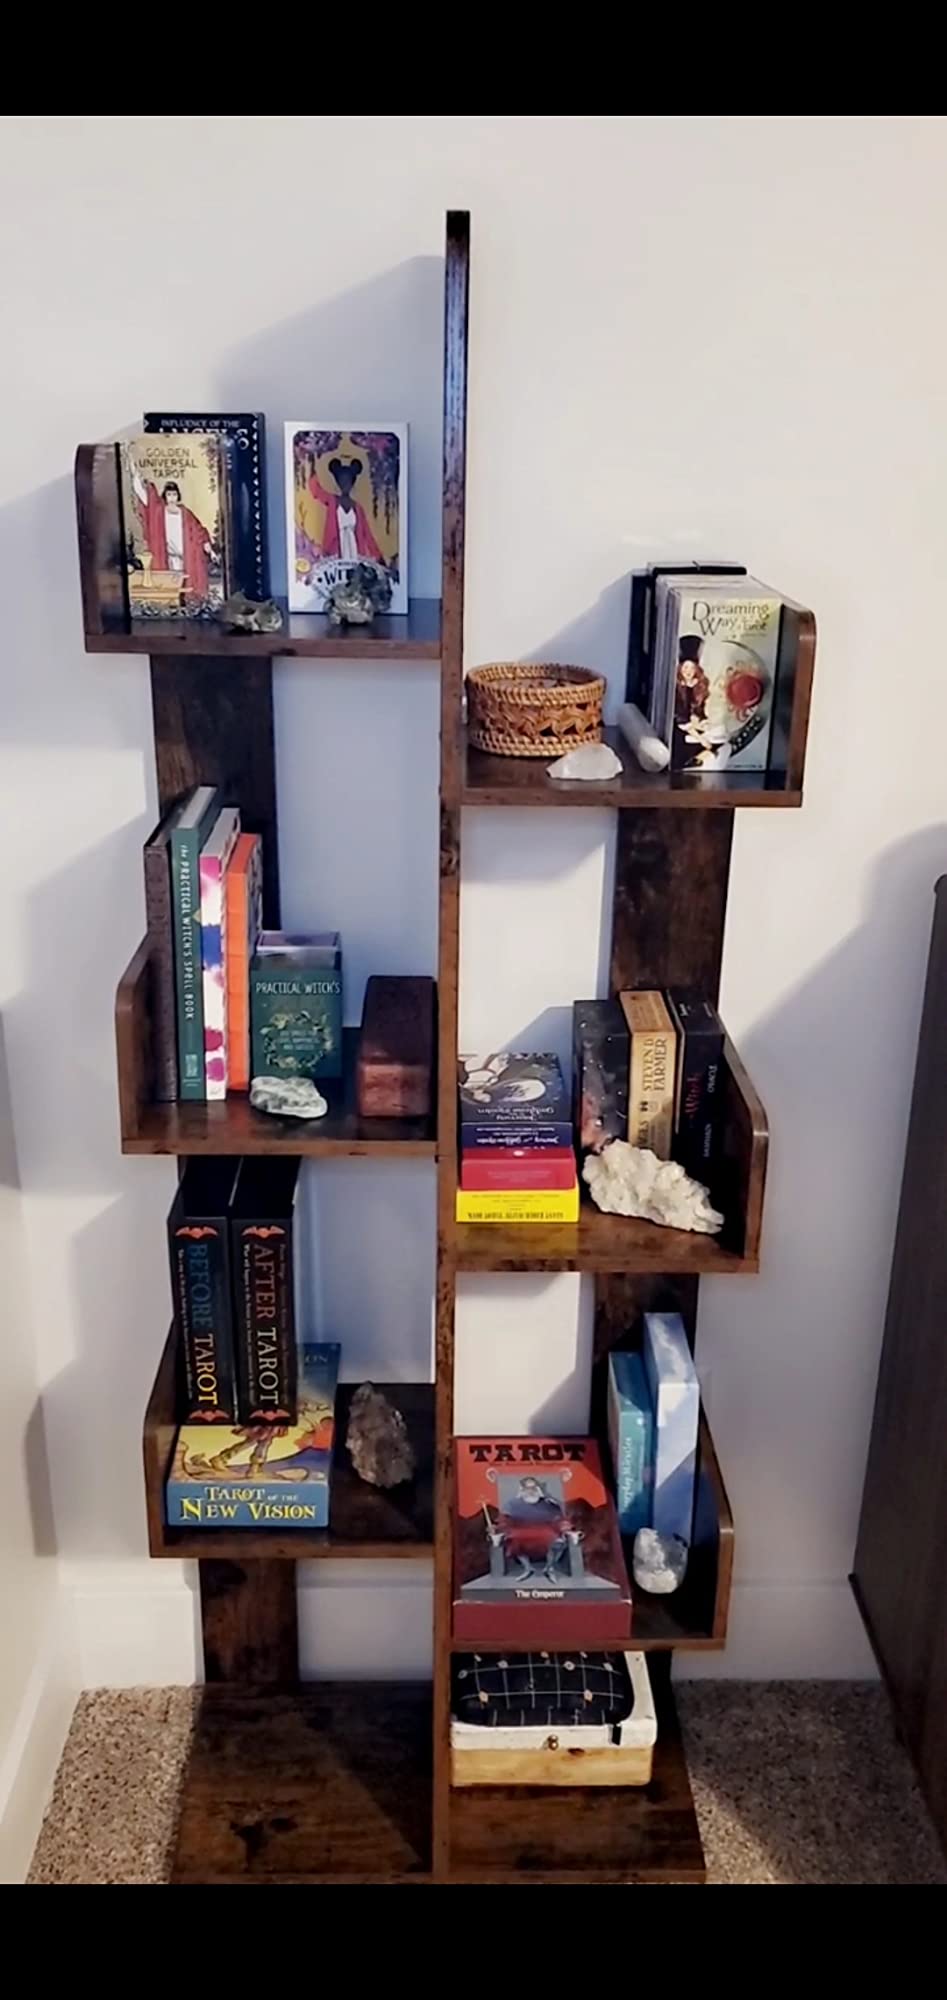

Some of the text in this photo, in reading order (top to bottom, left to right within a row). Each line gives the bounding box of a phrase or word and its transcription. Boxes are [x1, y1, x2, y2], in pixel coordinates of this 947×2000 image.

[160, 419, 241, 428] INFLUENCE OF THE
[145, 447, 191, 458] GOLDEN
[138, 458, 198, 469] UNIVERSAL
[153, 468, 186, 479] TAROT
[692, 601, 770, 621] Dreaming
[699, 616, 738, 636] Way
[182, 917, 192, 957] WITCH'S
[255, 981, 341, 994] PRACTICAL WITCH'S
[184, 993, 194, 1020] BOOK
[641, 1050, 653, 1092] STEVEN
[653, 1038, 668, 1092] FARMER
[187, 1244, 218, 1405] BEFORE TAROT
[254, 1244, 280, 1405] AFTER TAROT
[469, 1443, 586, 1463] TAROT
[248, 1502, 317, 1521] VISION
[514, 1589, 565, 1600] The Emperor
